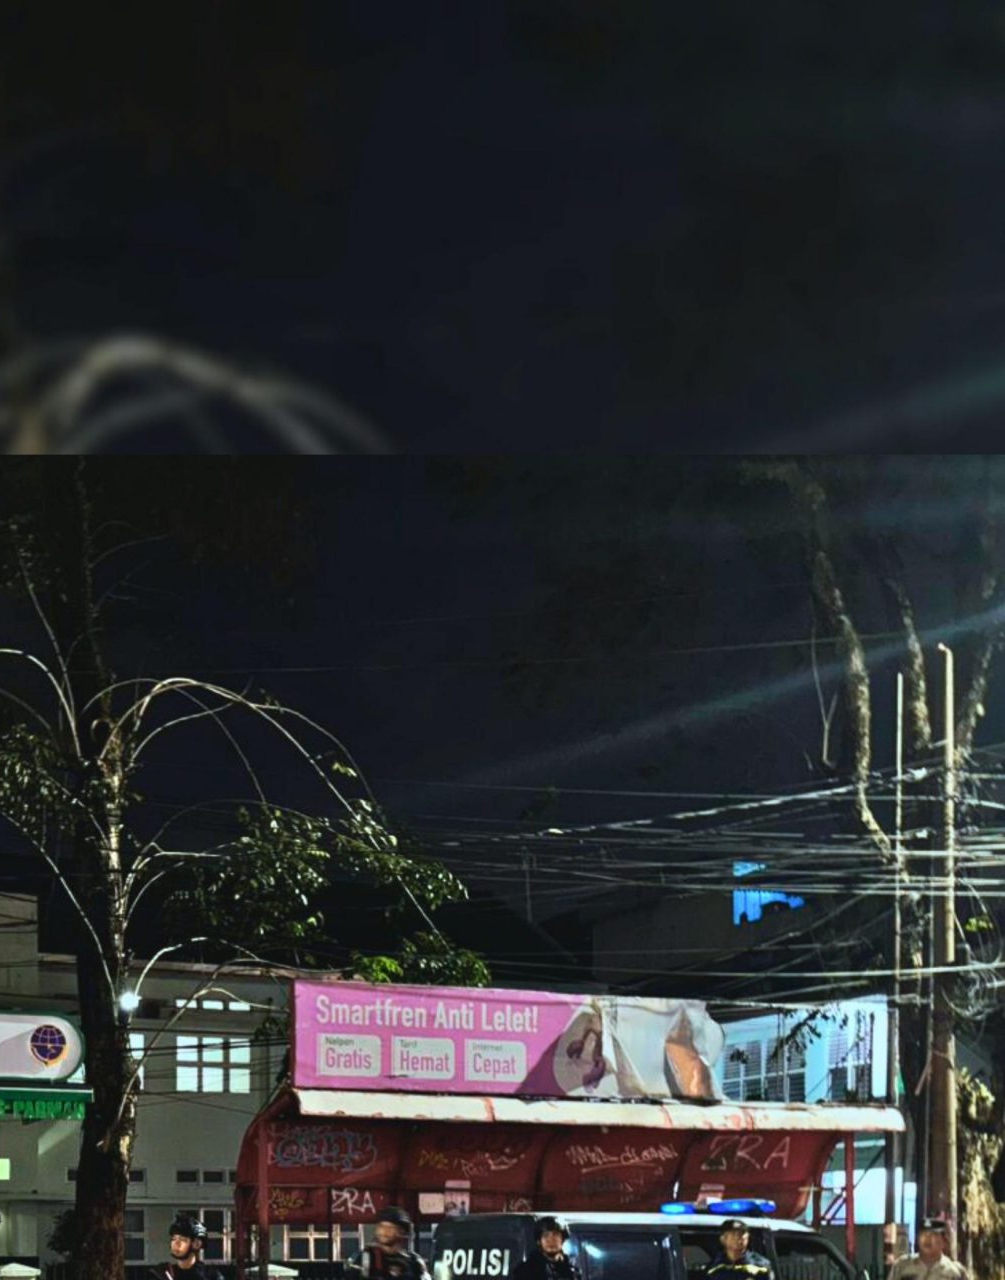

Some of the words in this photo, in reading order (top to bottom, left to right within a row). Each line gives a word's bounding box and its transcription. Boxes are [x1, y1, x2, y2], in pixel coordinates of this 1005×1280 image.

[316, 995, 426, 1028] Smartfren
[434, 1002, 473, 1030] Anti
[481, 1003, 538, 1033] Lelet!
[325, 1048, 372, 1070] Gratis
[400, 1051, 450, 1072] Hemat
[473, 1053, 516, 1077] Cepat
[331, 1187, 376, 1215] ZRA
[443, 1249, 510, 1276] POLISI
